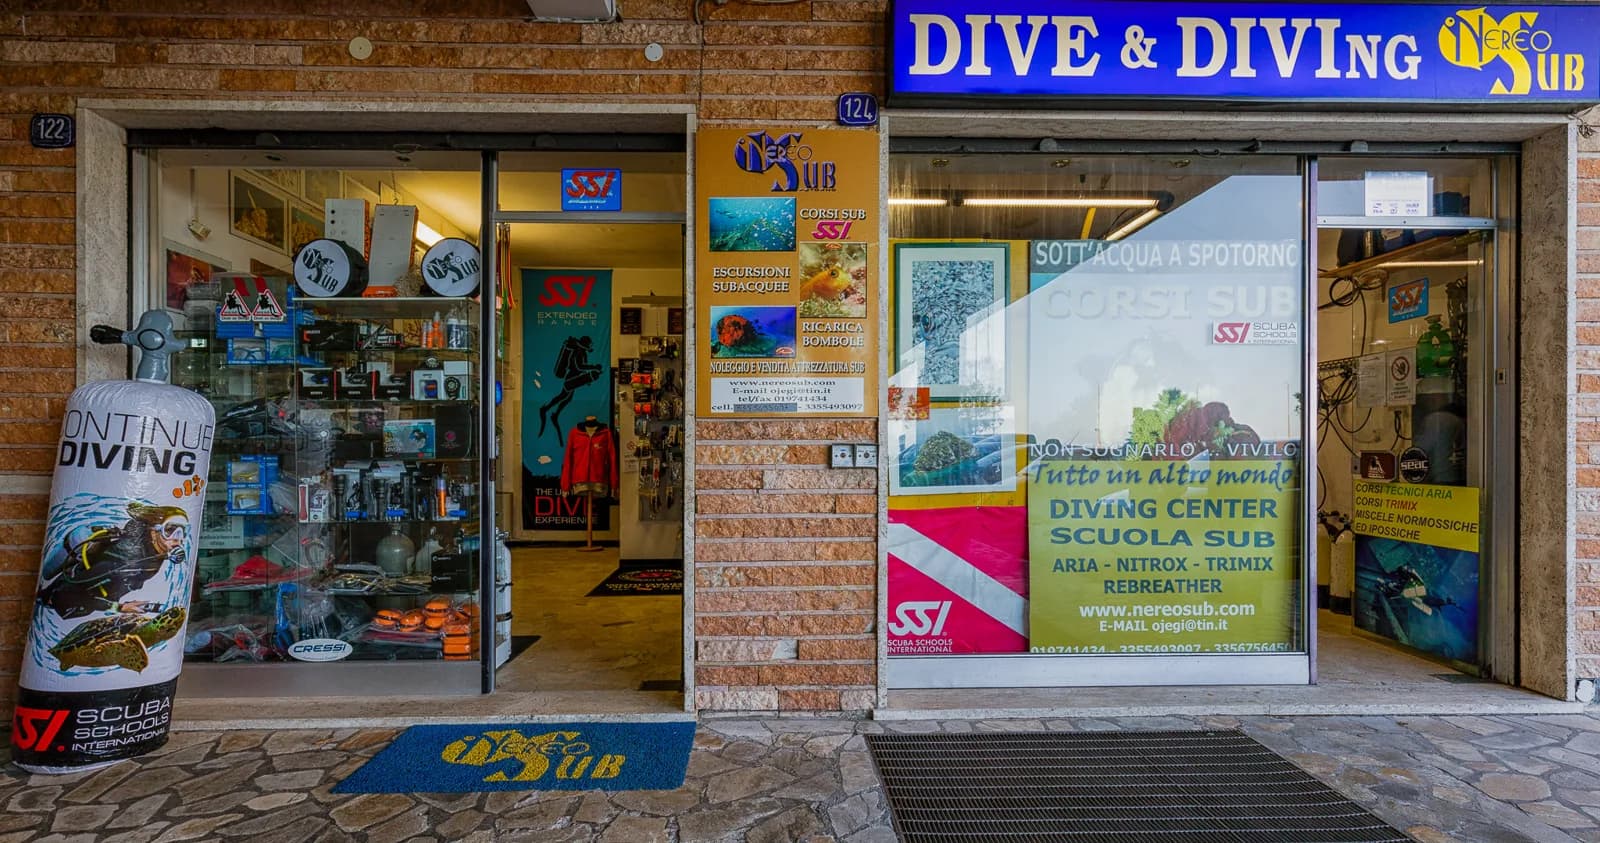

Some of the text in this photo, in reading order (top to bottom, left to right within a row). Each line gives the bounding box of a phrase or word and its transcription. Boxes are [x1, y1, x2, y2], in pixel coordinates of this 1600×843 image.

[908, 14, 1101, 77] DIVE
[1120, 24, 1158, 69] &
[844, 97, 873, 120] 124
[37, 117, 66, 140] 122
[566, 171, 616, 198] SSI
[799, 208, 867, 220] CORSI SUB
[812, 220, 853, 240] SSI
[1035, 240, 1167, 272] SOTT'ACQUA
[1168, 243, 1183, 266] A
[713, 266, 791, 279] ESCURSIONI
[538, 275, 597, 307] SSI
[713, 281, 790, 294] SUBACQUEE
[1046, 284, 1297, 320] CORSI SUB
[537, 311, 598, 319] EXTENDED
[802, 322, 864, 334] RICARICA
[1214, 322, 1251, 343] SSI
[1253, 322, 1297, 331] SCUBA
[1253, 331, 1297, 339] SCHOOLS
[802, 336, 864, 348] BOMBOLE
[710, 361, 750, 374] NOLEGGIO
[751, 361, 757, 374] E
[758, 361, 789, 374] VENDITA
[850, 361, 866, 374] SUB
[729, 379, 837, 387] www.nereosub.com
[732, 387, 767, 395] E-mail
[711, 403, 734, 411] cell.
[738, 395, 771, 403] tel/fax
[64, 409, 214, 453] ONTINUE
[58, 440, 198, 476] DIVING
[1029, 442, 1078, 458] NON
[1080, 441, 1197, 458] SOGNARLO
[1226, 442, 1297, 458] VIVILO
[1400, 459, 1429, 470] seac
[1032, 461, 1294, 491] Tutto un altro mondo
[1355, 483, 1453, 500] CORSI TECNICI ARIA
[1050, 498, 1279, 519] DIVING CENTER
[1355, 496, 1418, 512] CORSI TRIMIX
[535, 516, 600, 525] EXPERIENE
[1355, 508, 1479, 534] MISCELE NORMOSSICHE
[1050, 527, 1276, 548] SCUOLA SUB
[1355, 522, 1421, 541] ED IPOSSICHE
[1052, 557, 1099, 573] ARIA
[1116, 557, 1188, 573] NITROX
[1205, 556, 1274, 571] TRIMIX
[1103, 578, 1223, 594] REBREATHER
[1079, 601, 1256, 617] www.nereosub.com
[888, 600, 953, 636] SSI
[1099, 618, 1229, 636] E-MAIL ojegi@tin.it
[293, 643, 347, 653] CRESSI
[887, 638, 953, 647] SCUBA SCHOOLS
[887, 645, 953, 653] INTERNATIONAL
[76, 696, 171, 724] SCUBA
[13, 706, 70, 752] SI
[73, 712, 169, 740] SCHOOLS
[71, 726, 167, 752] INTERNATIONAL
